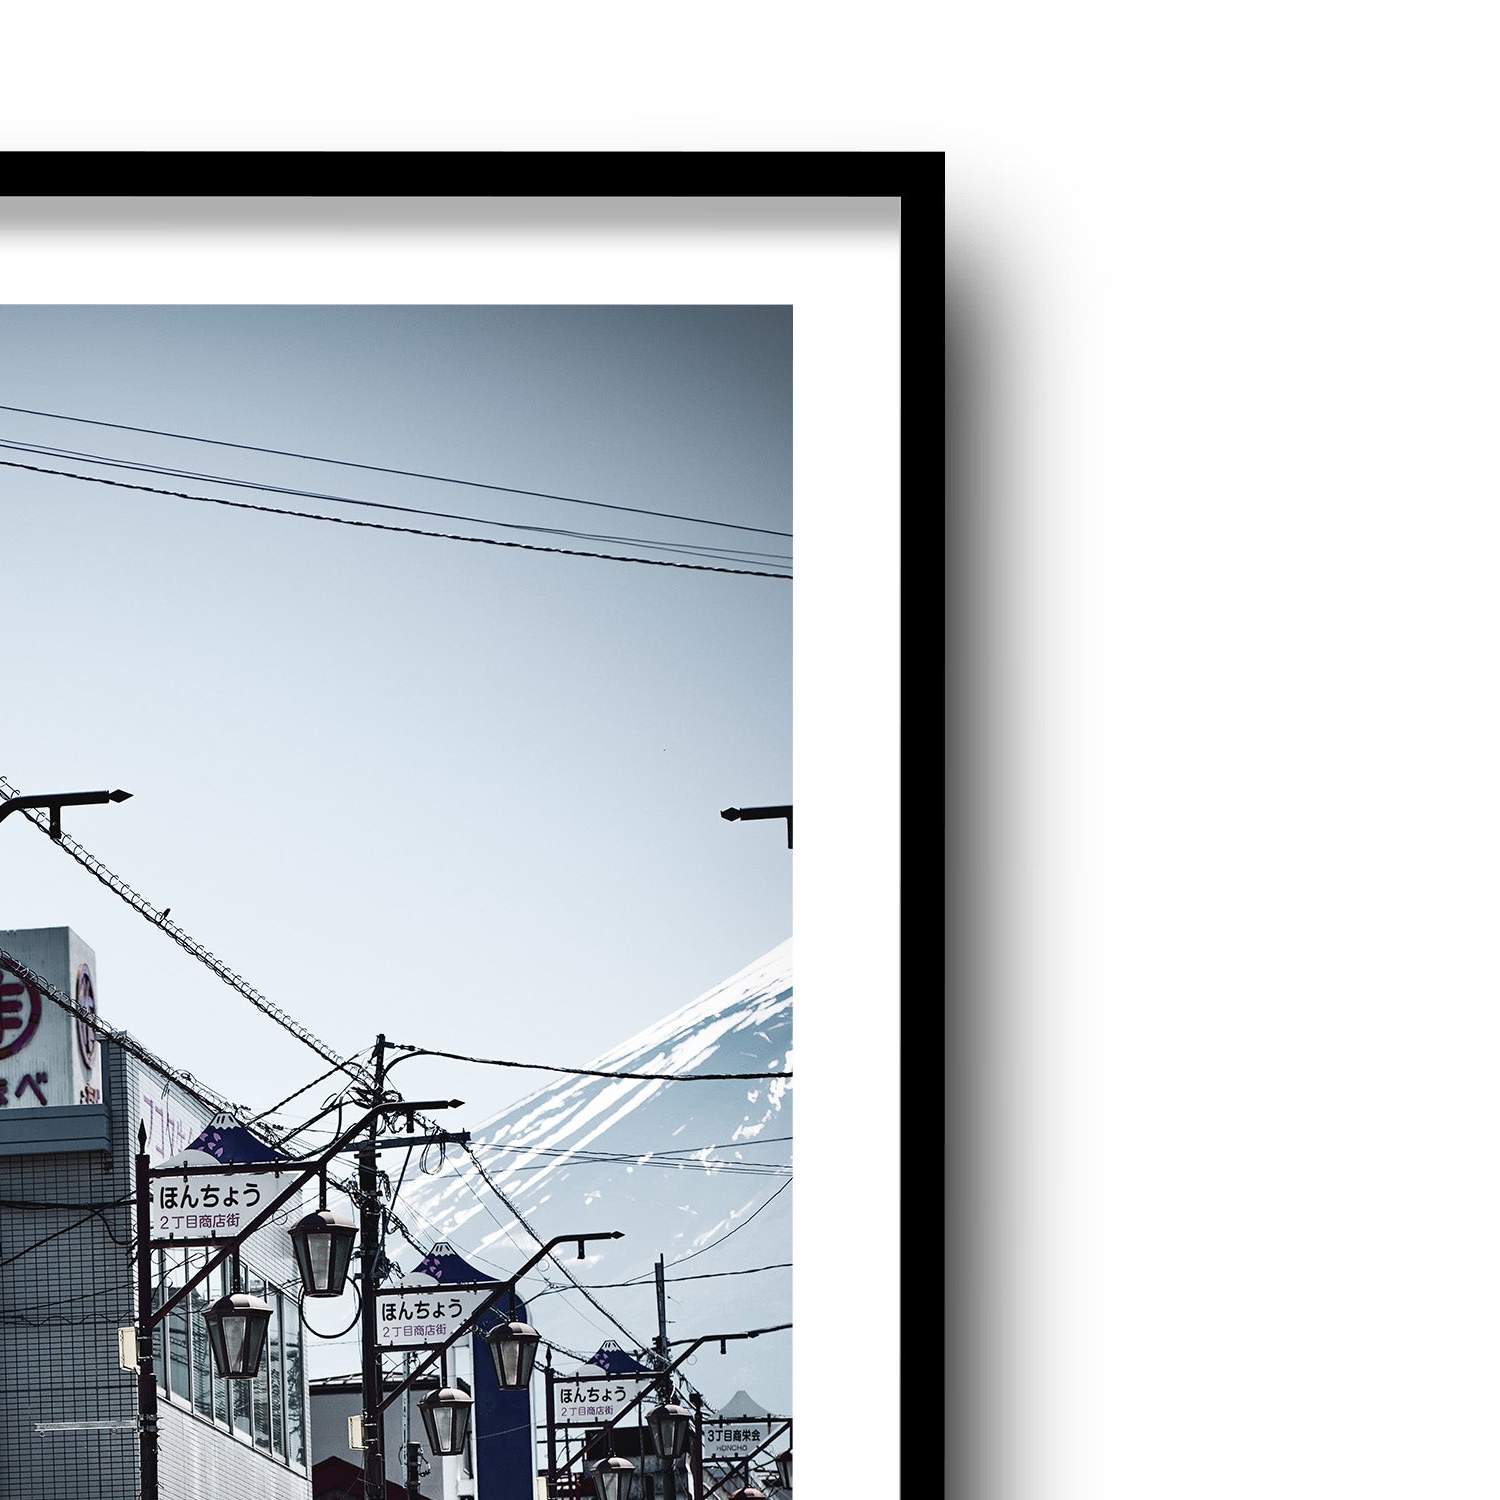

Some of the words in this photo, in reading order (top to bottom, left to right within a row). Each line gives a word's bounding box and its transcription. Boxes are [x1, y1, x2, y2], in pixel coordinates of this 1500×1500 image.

[160, 1183, 261, 1209] ほんちょう
[160, 1213, 240, 1229] 2丁目商店街
[382, 1299, 463, 1321] ほんちょう
[382, 1323, 447, 1338] 2丁目商店街
[560, 1386, 626, 1403] ほんちょう
[561, 1405, 614, 1416] 2丁目商店街
[707, 1429, 761, 1442] 3丁目商栄会
